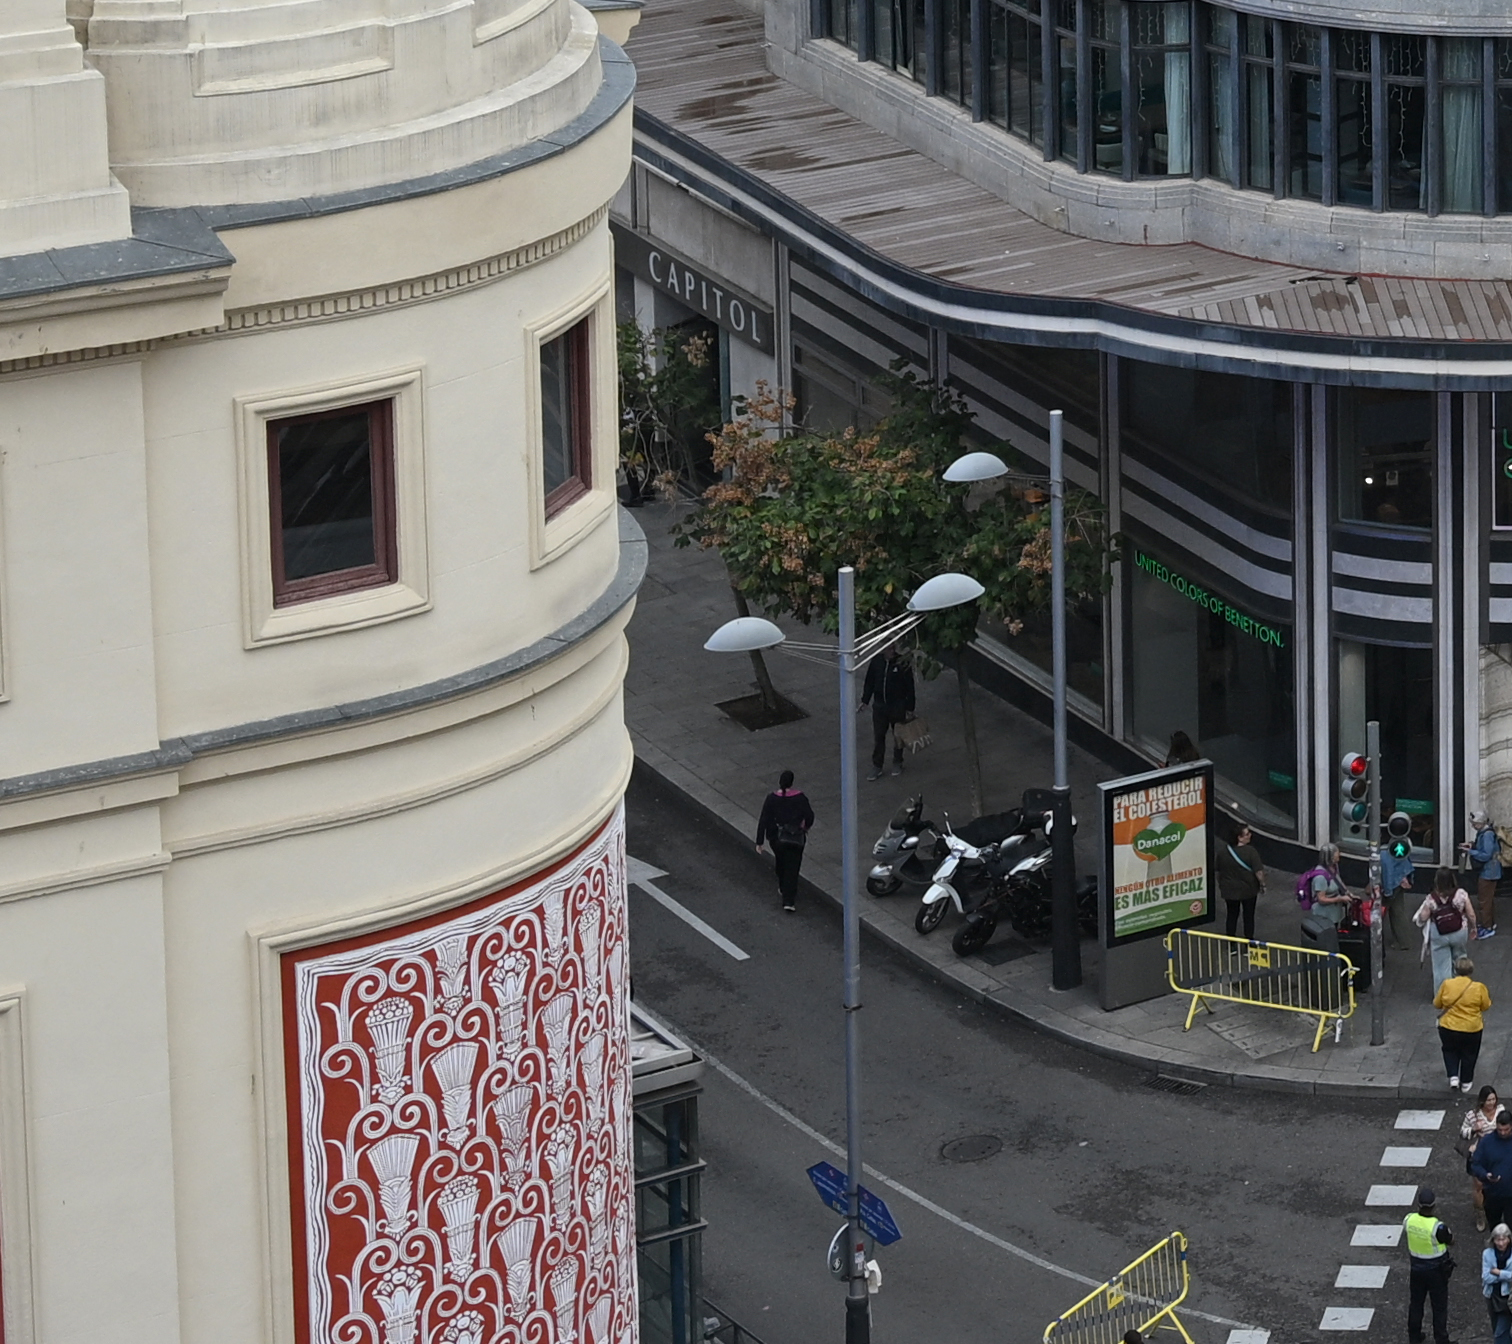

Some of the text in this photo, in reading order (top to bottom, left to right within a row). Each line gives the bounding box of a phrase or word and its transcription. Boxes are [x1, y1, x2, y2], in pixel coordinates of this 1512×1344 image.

[648, 251, 760, 344] CAPITOL
[1134, 550, 1168, 582] UNITED
[1169, 573, 1209, 609] COLORS
[1209, 597, 1224, 616] OF
[1113, 776, 1203, 810] PARA REDUCIR
[1113, 791, 1203, 823] EL COLESTEROL
[1137, 831, 1181, 850] Danacol
[1166, 867, 1203, 883] ALIMENTO
[1115, 877, 1204, 911] ES MÁS EFICAZ
